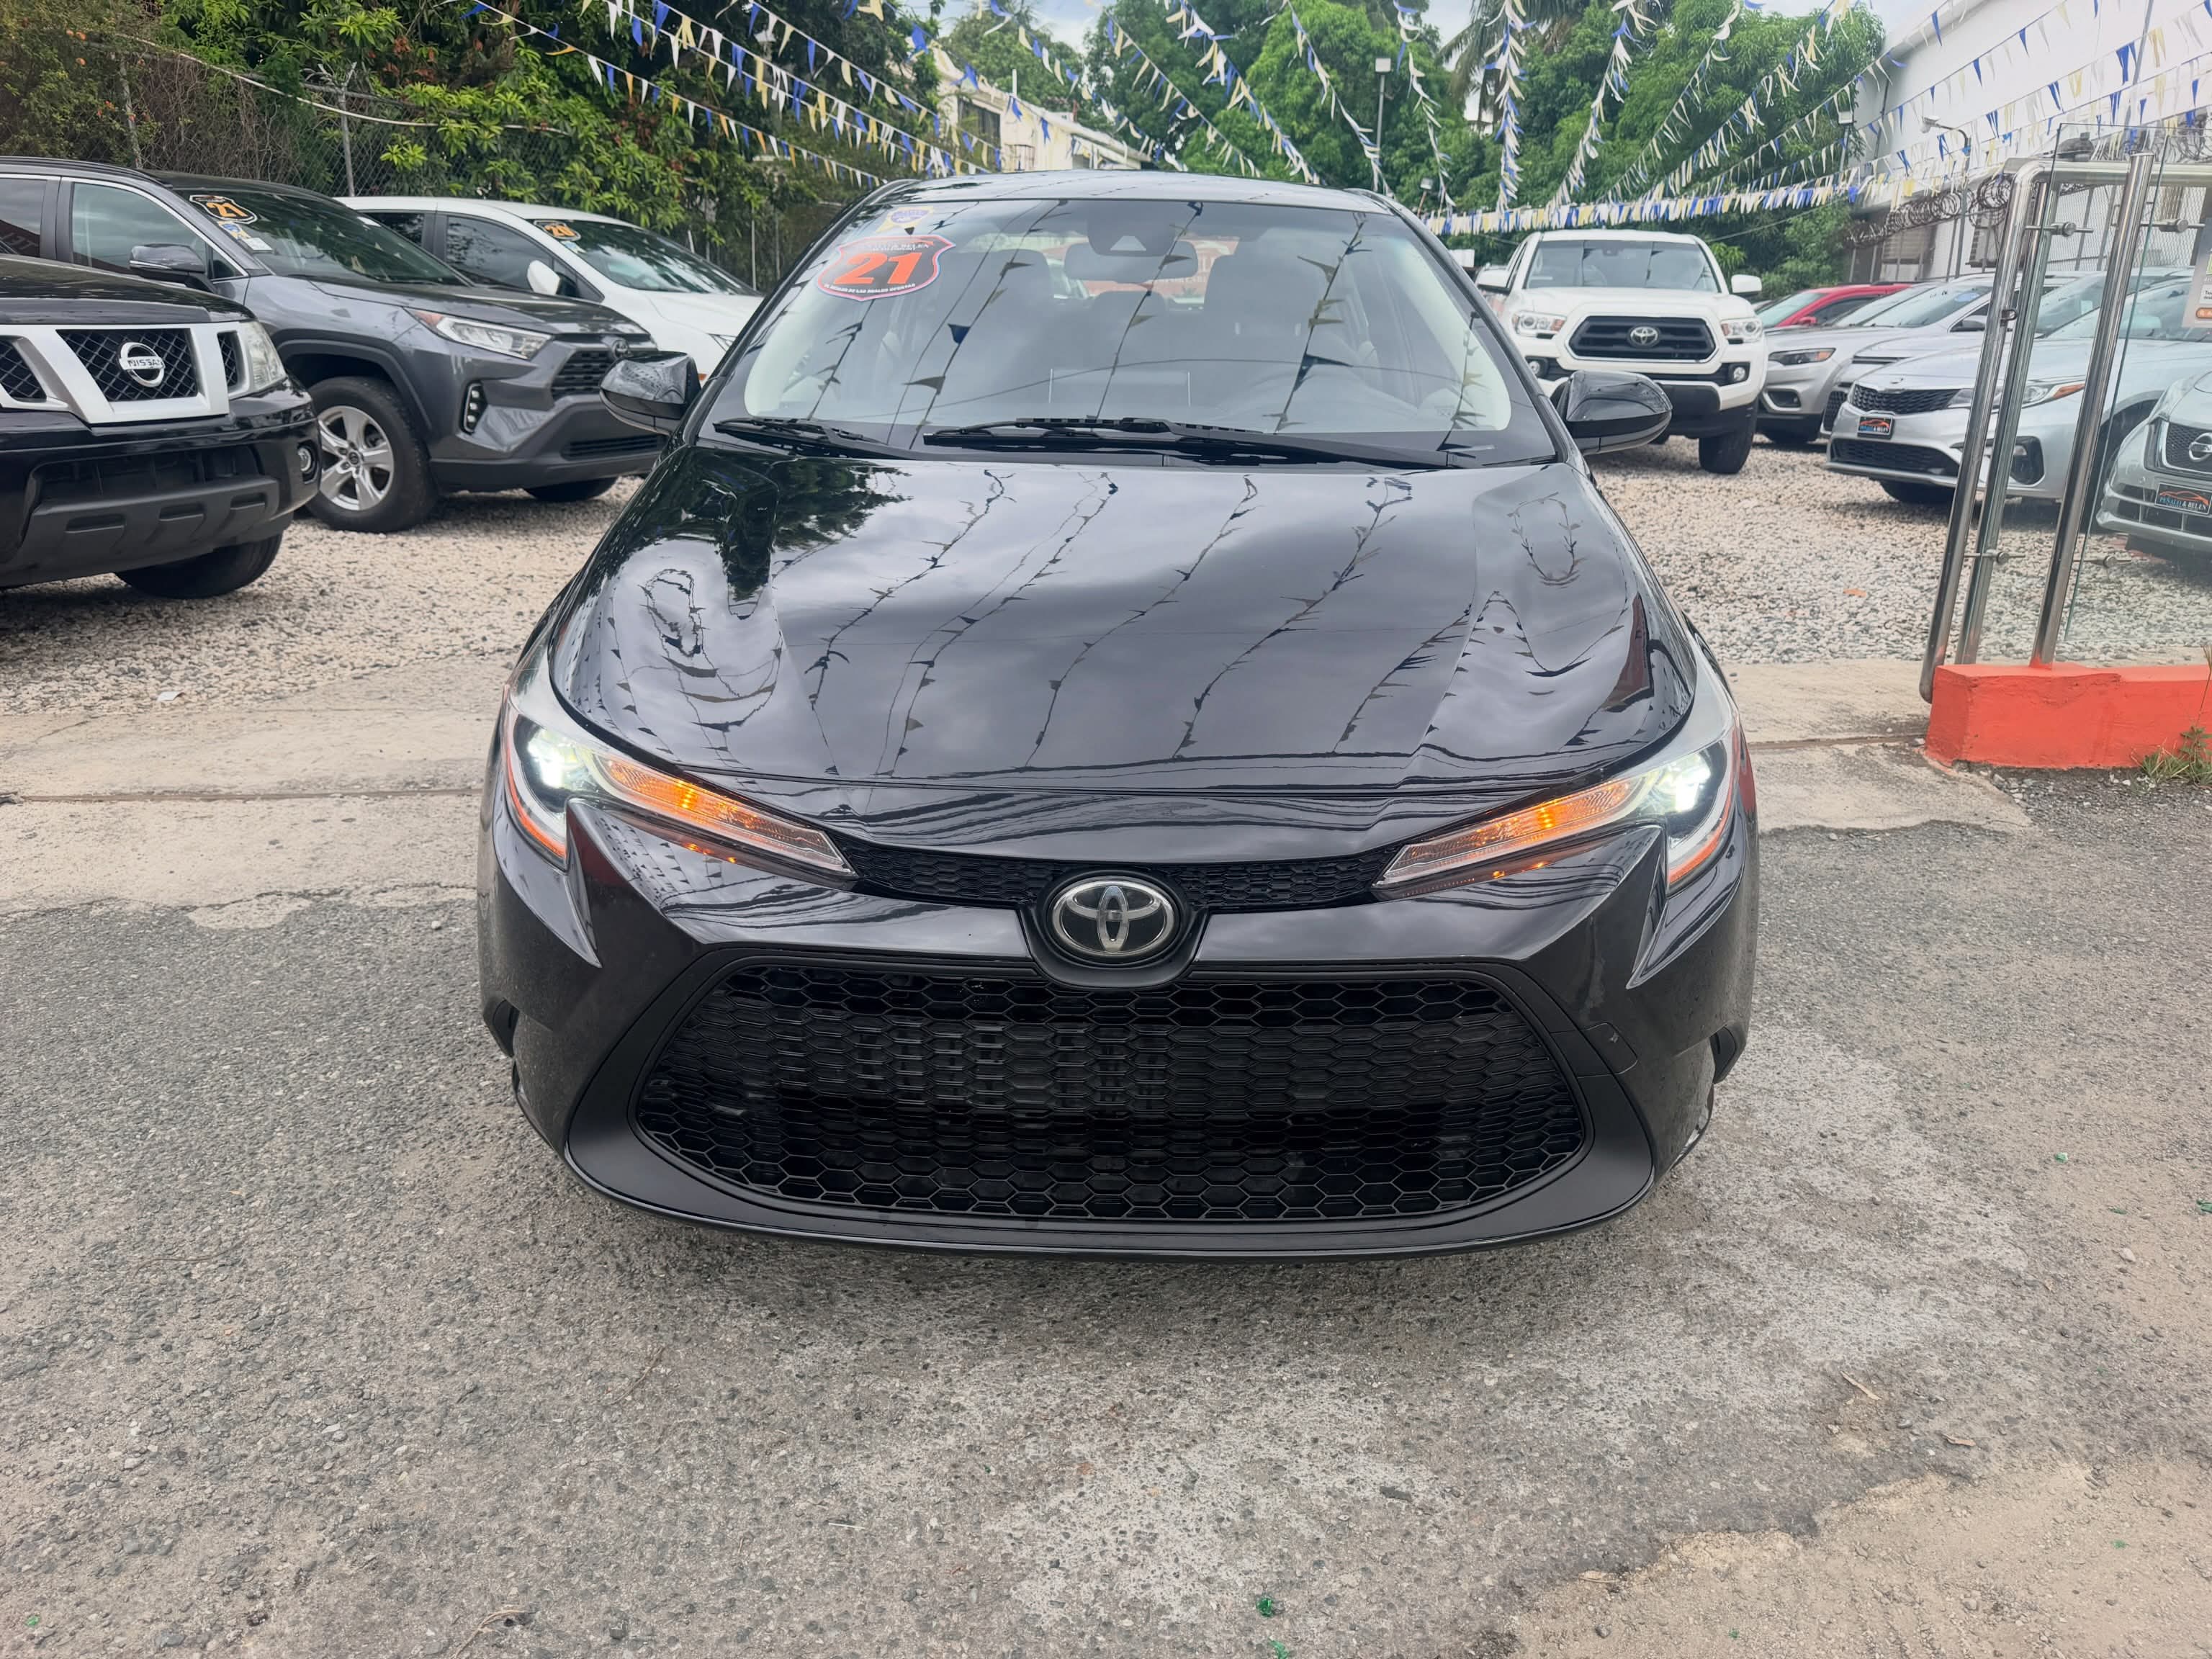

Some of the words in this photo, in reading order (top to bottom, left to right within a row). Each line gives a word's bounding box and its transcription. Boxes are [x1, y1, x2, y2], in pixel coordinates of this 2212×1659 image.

[206, 202, 248, 217] 21
[834, 253, 922, 284] 21
[127, 359, 164, 367] NISSAN
